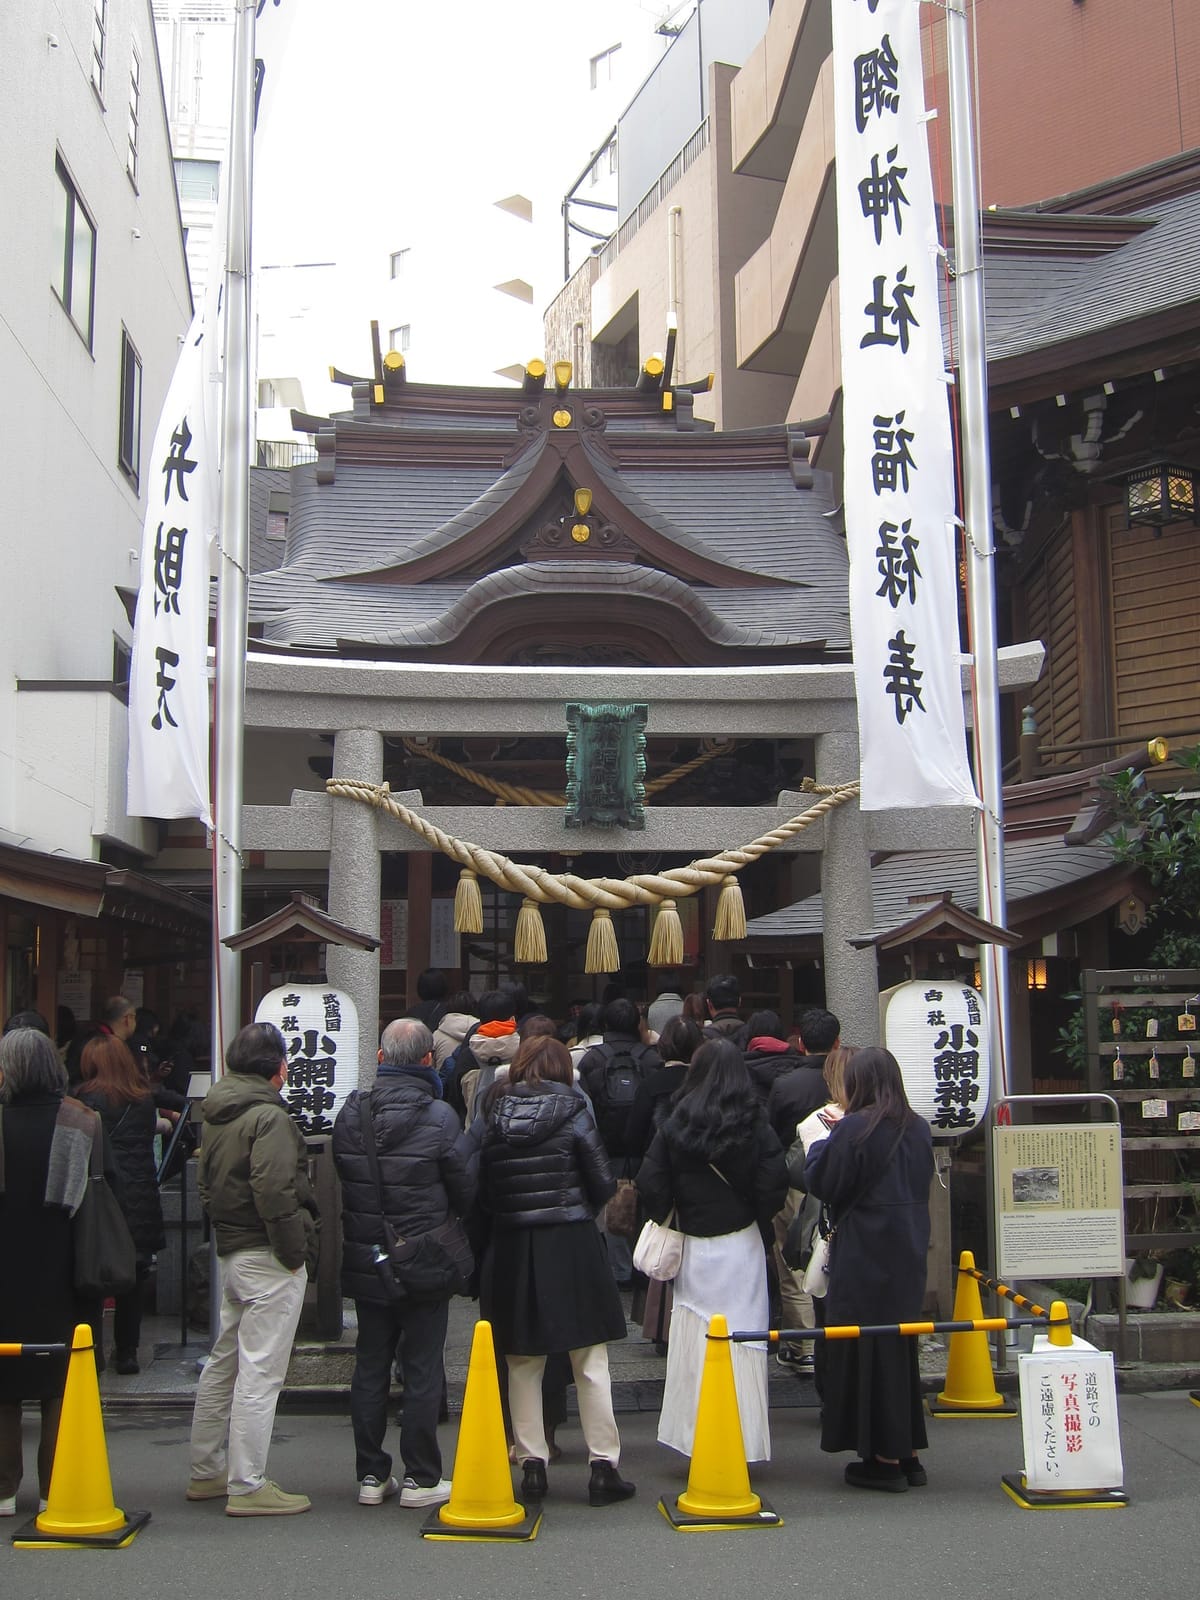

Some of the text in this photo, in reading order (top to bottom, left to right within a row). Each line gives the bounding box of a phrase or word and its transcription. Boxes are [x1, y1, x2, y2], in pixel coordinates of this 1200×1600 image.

[322, 993, 342, 1033] 武蔵国
[961, 988, 981, 1026] 武蔵国
[286, 1029, 337, 1135] 小網神社
[930, 1023, 980, 1129] 小網神社
[1040, 1374, 1061, 1478] ご遠慮ください。
[1060, 1372, 1083, 1454] 写真撮影
[1085, 1372, 1101, 1428] 道路での
